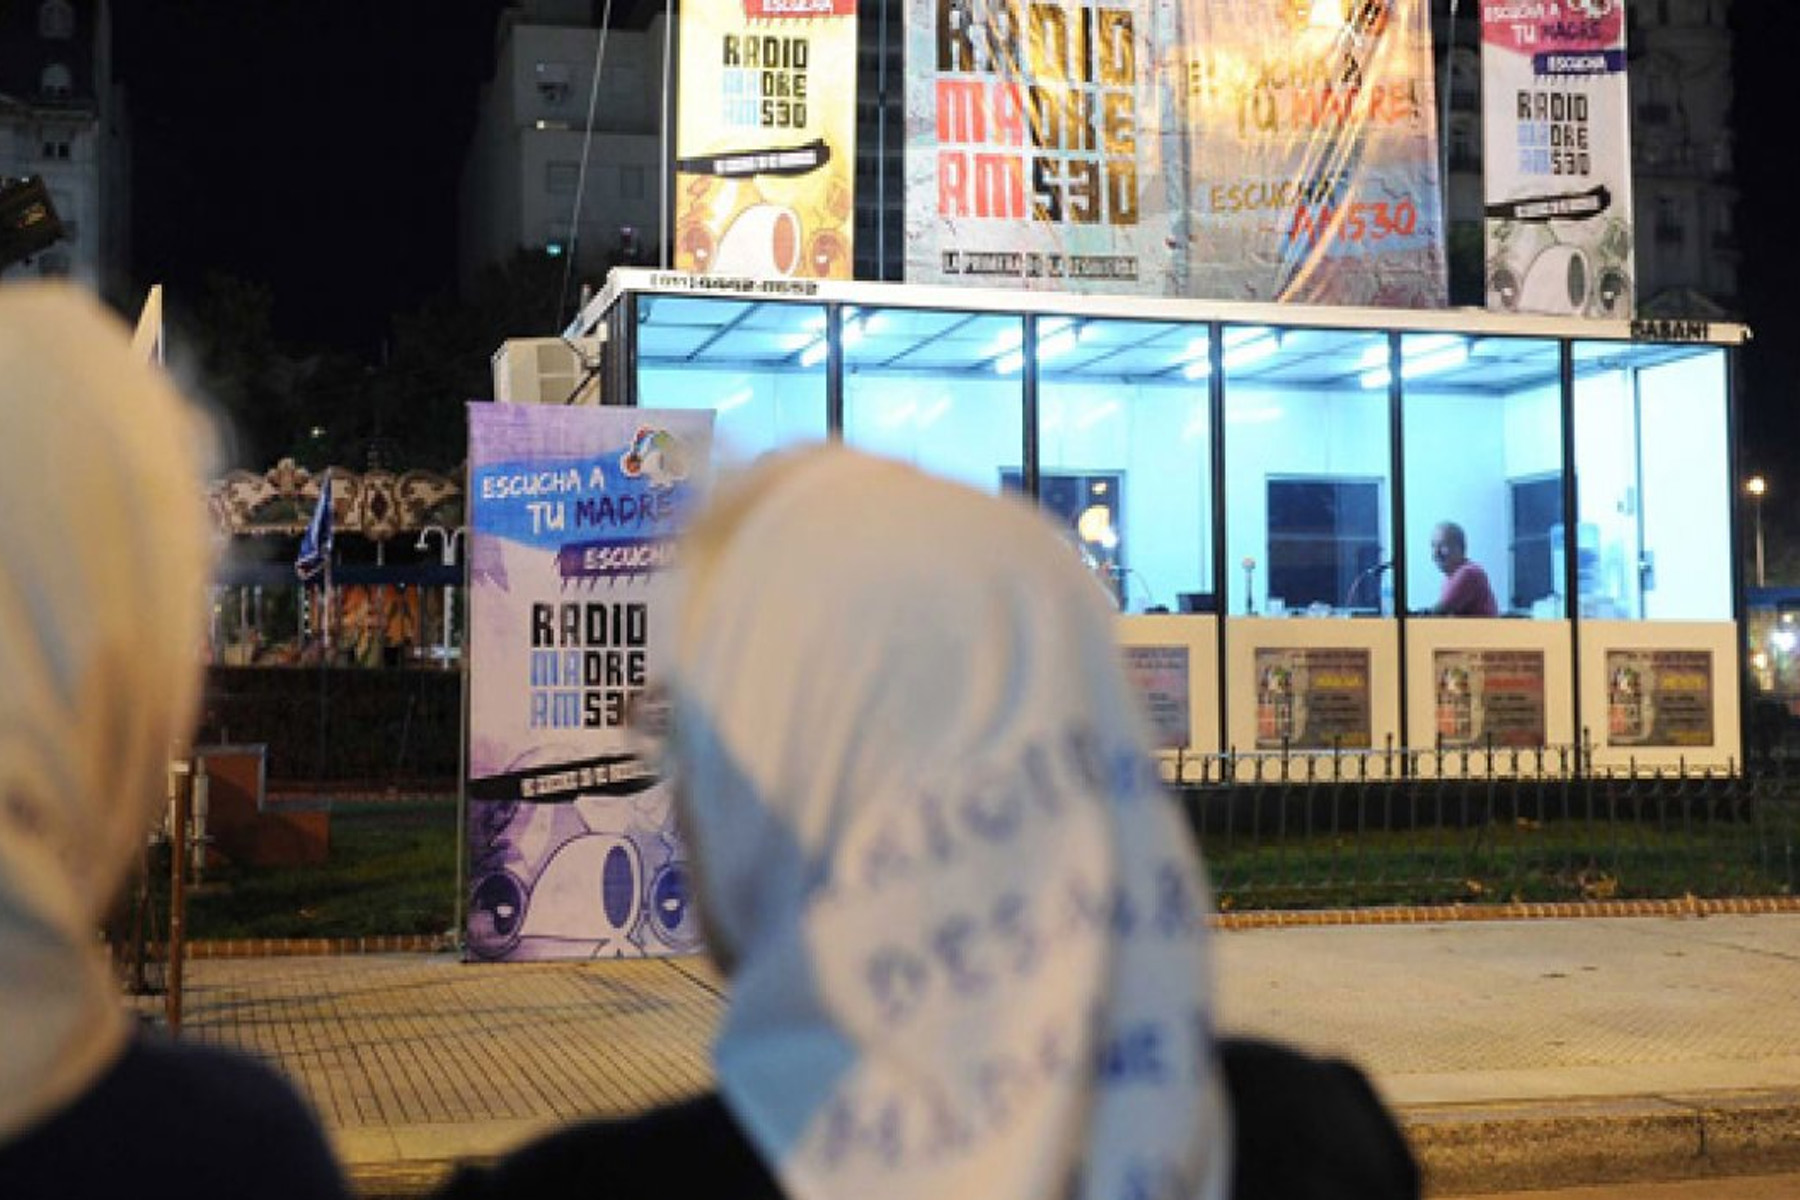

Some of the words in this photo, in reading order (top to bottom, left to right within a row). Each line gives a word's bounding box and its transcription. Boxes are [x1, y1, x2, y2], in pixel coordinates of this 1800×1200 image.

[723, 34, 808, 69] RADIO
[935, 0, 1135, 85] RADIO
[1511, 24, 1536, 45] TU
[935, 79, 1136, 154] MADRE
[1517, 89, 1588, 122] RADIO
[483, 468, 581, 498] ESCUCHA
[589, 467, 605, 489] A
[527, 502, 565, 533] TU
[576, 493, 672, 528] MADRE
[533, 603, 647, 647] RADIO
[531, 650, 645, 686] MADRE
